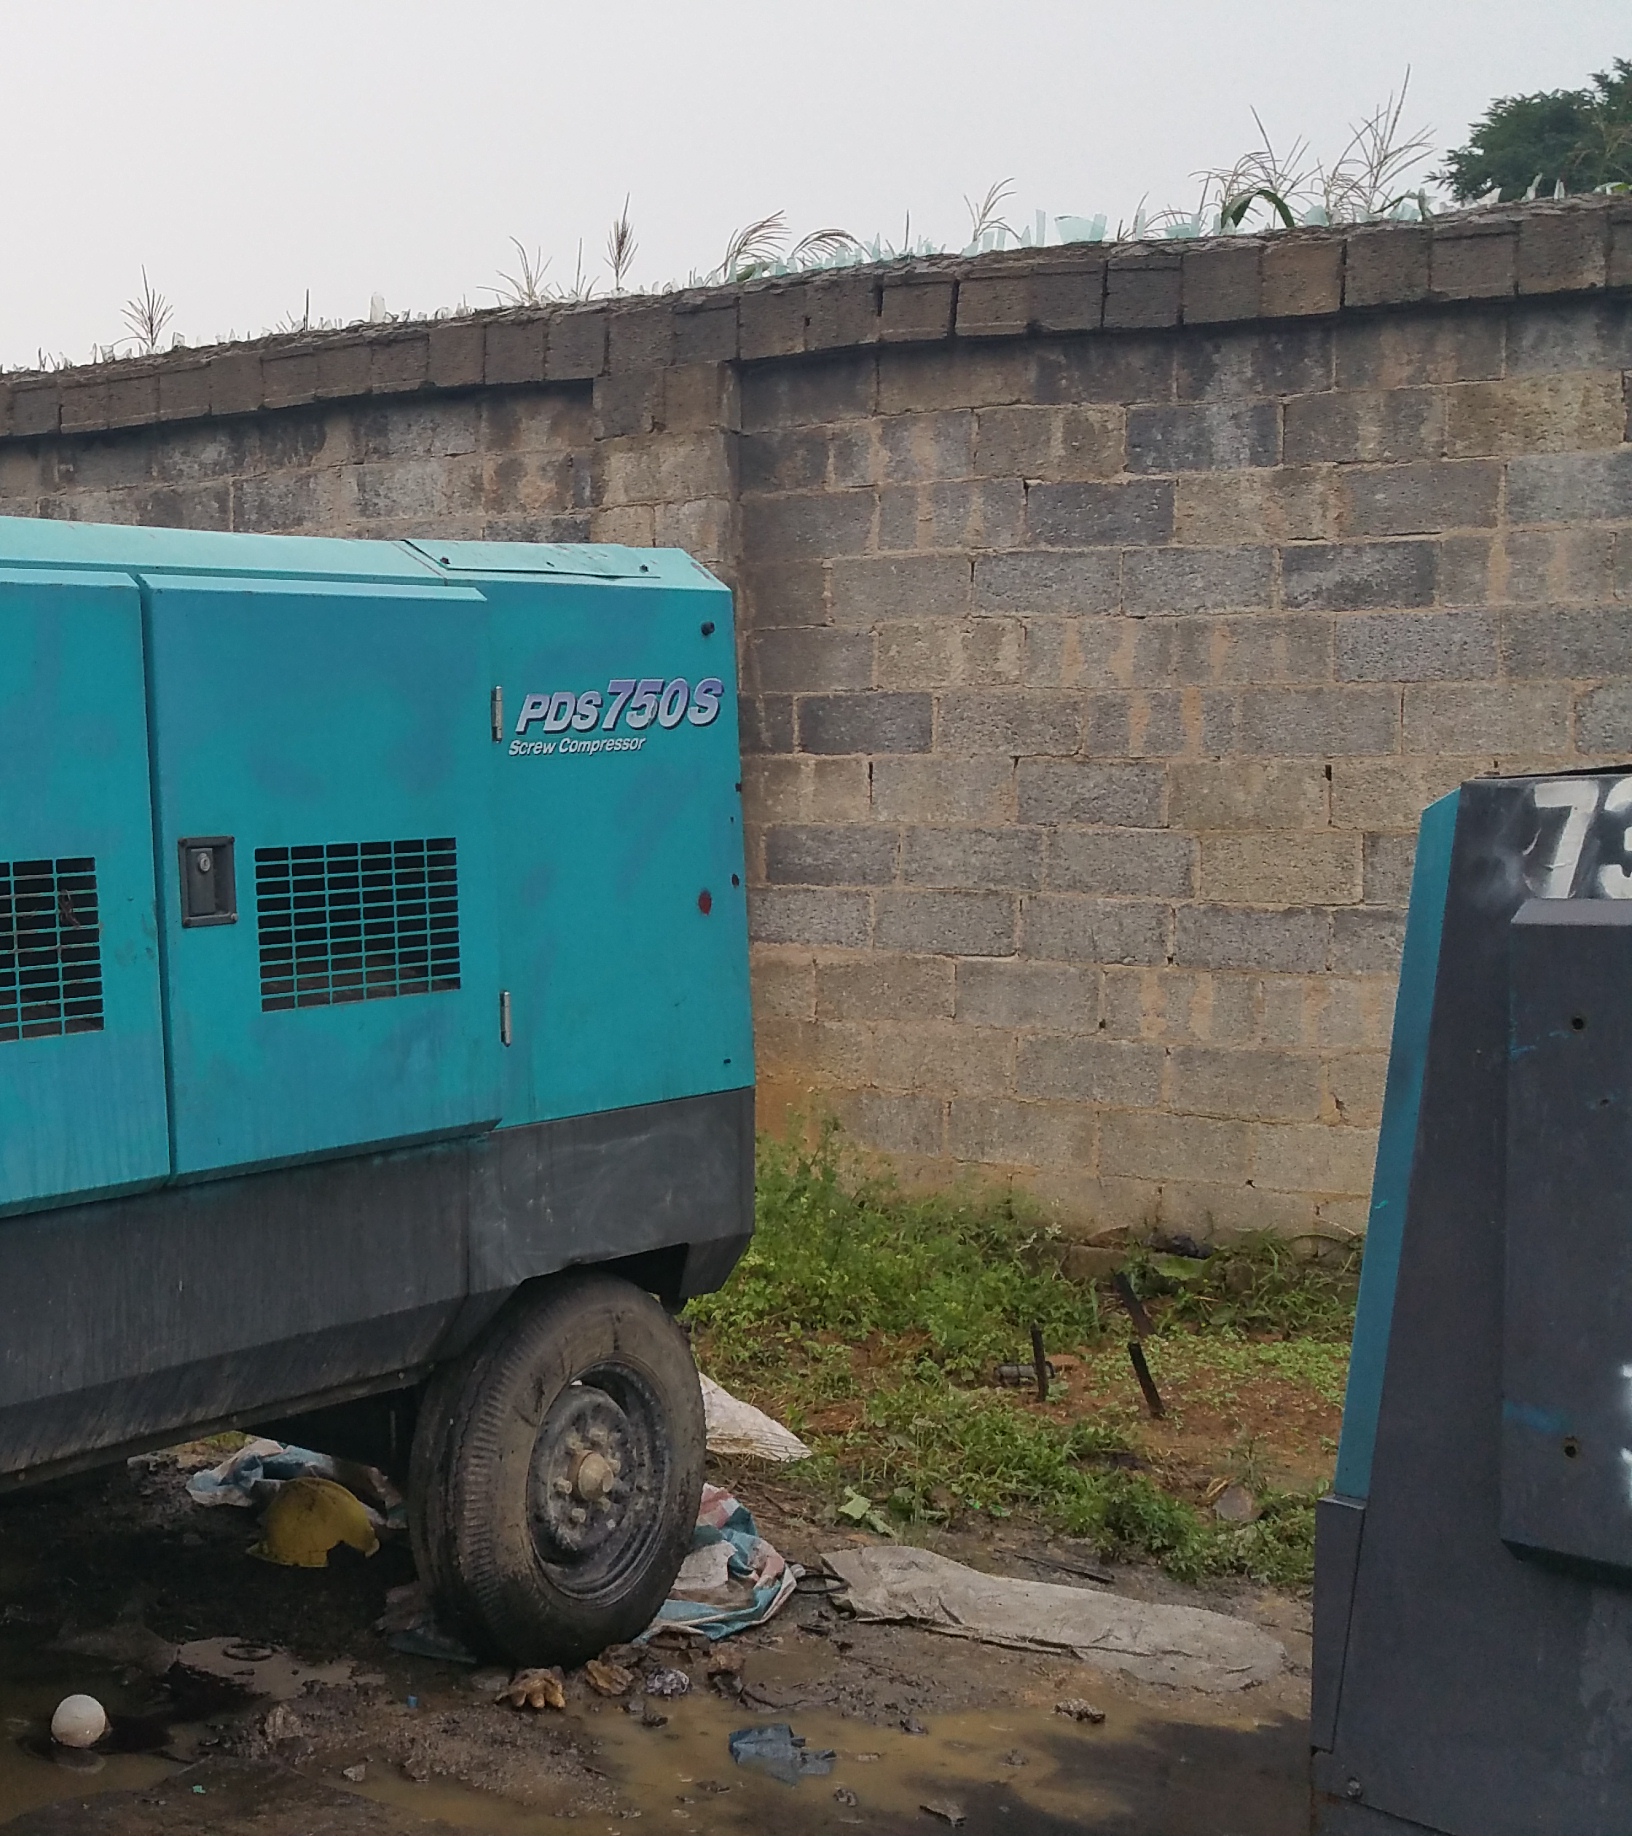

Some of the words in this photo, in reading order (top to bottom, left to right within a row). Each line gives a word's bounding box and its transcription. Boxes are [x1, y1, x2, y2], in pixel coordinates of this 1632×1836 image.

[515, 677, 724, 736] PDS750S
[509, 739, 557, 756] Screw
[558, 736, 647, 755] Compressor
